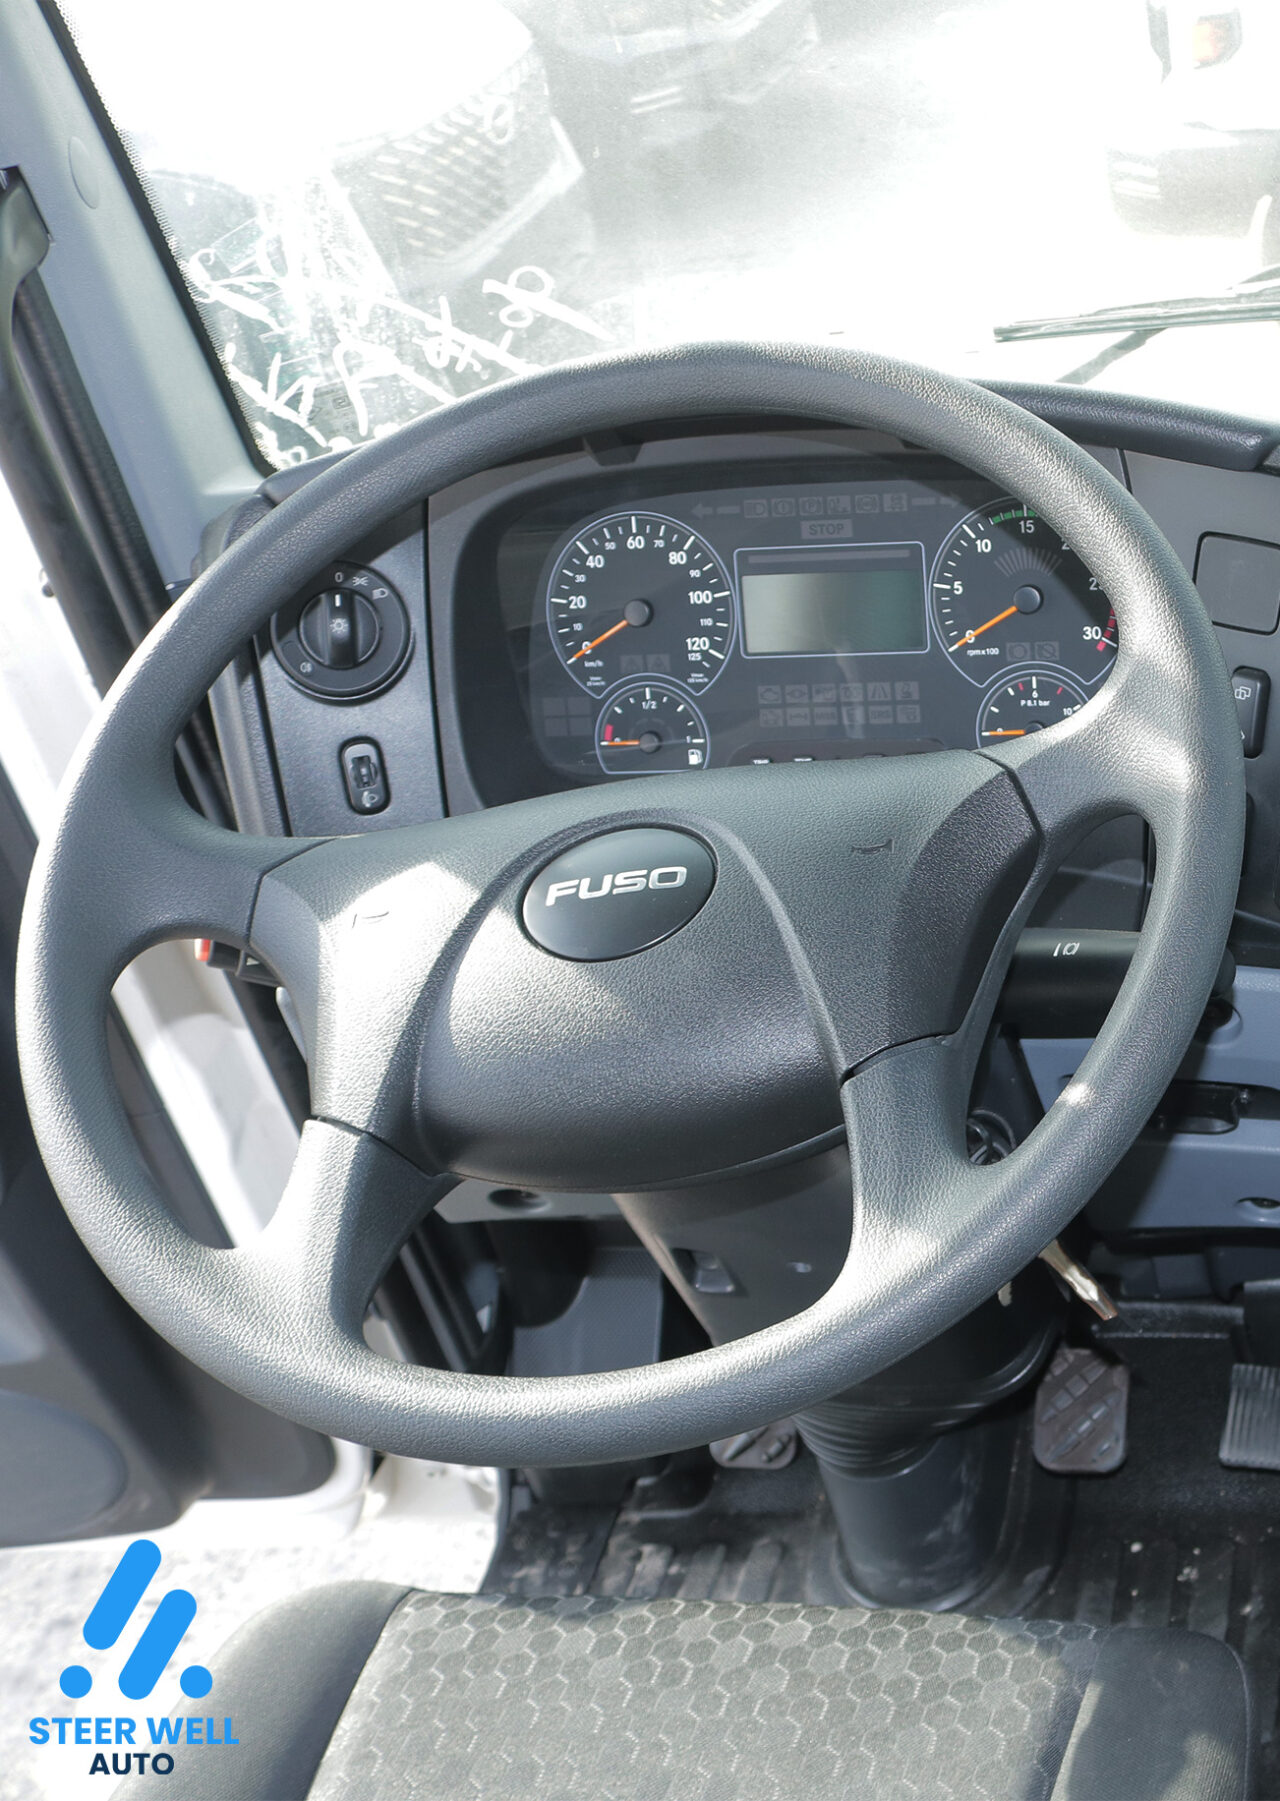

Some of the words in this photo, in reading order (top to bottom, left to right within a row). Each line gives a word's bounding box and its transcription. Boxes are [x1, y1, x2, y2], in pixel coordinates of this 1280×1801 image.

[808, 523, 845, 536] STOP
[1020, 520, 1035, 533] 15
[604, 541, 616, 550] 50
[626, 536, 645, 549] 60
[653, 540, 665, 549] 70
[976, 539, 992, 552] 10
[586, 555, 604, 568] 40
[669, 551, 687, 565] 80
[335, 573, 343, 583] 0
[575, 574, 587, 583] 30
[689, 569, 700, 578] 90
[953, 582, 963, 594] 5
[568, 596, 587, 609] 20
[687, 591, 713, 604] 100
[573, 623, 583, 631] 10
[700, 618, 713, 626] 110
[1082, 627, 1102, 641] 30
[686, 637, 710, 651] 120
[687, 652, 702, 661] 125
[584, 659, 604, 668] km/h
[1032, 690, 1039, 699] 6
[642, 701, 657, 710] 1/2
[1038, 699, 1051, 707] bar
[1063, 708, 1072, 716] 10
[545, 866, 688, 907] FUSO
